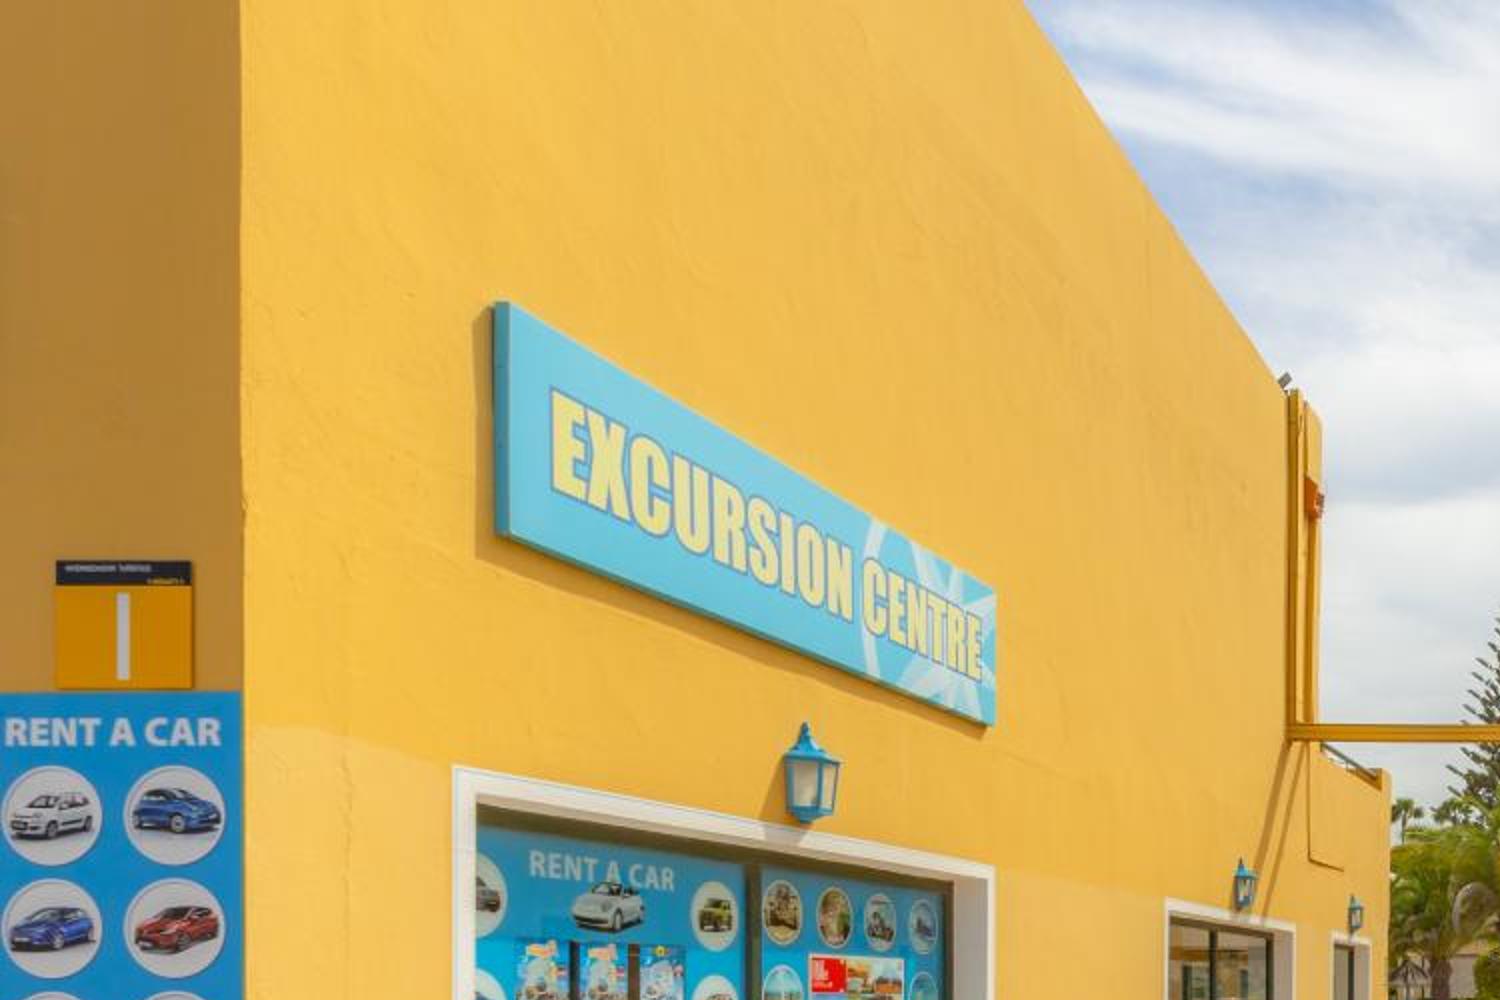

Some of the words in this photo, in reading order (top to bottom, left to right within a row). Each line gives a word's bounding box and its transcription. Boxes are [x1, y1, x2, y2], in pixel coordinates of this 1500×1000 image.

[549, 385, 854, 624] EXCURSION
[862, 556, 984, 683] CENTRE
[4, 717, 101, 747] RENT
[109, 717, 136, 747] A
[144, 717, 222, 747] CAR
[529, 849, 599, 883] RENT
[606, 859, 622, 884] A
[628, 863, 675, 891] CAR
